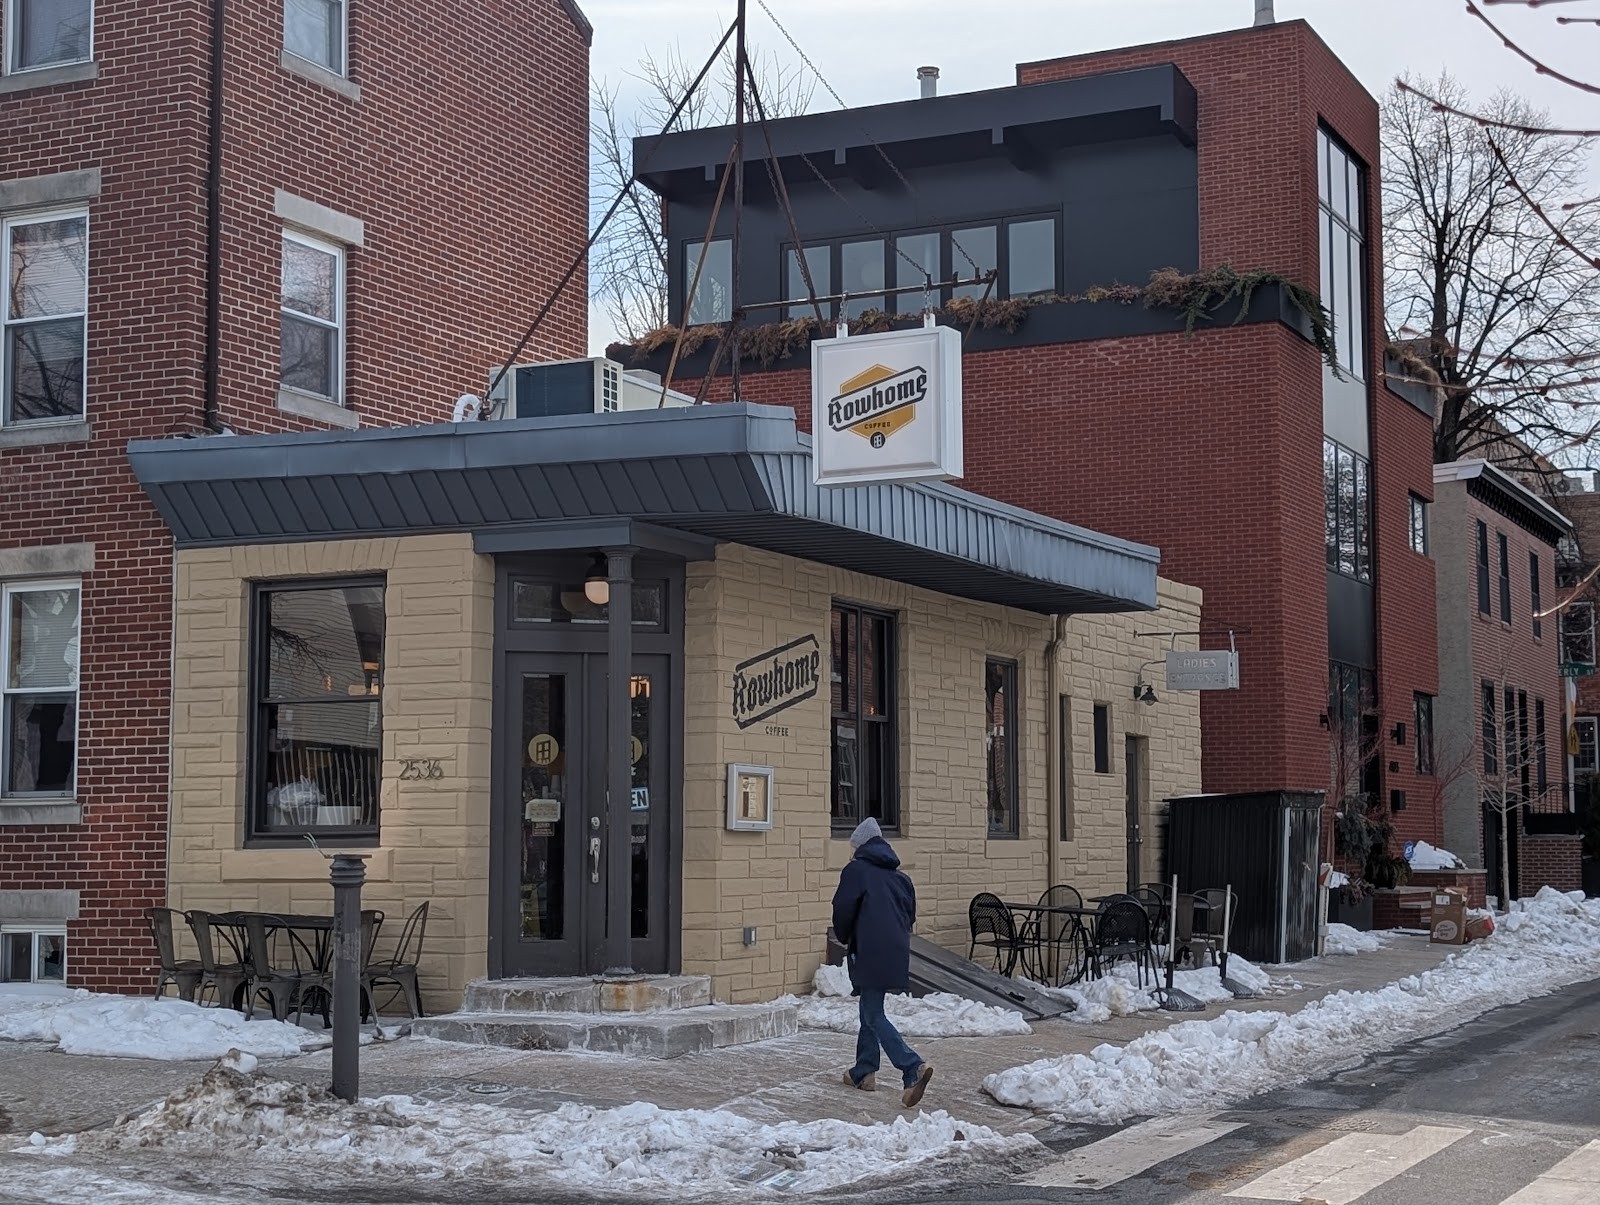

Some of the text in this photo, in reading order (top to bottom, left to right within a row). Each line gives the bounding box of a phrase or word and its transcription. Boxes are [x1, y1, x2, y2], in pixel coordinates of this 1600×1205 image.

[828, 374, 927, 426] Rowhome
[864, 421, 891, 430] COFFEE
[1177, 658, 1217, 668] LADIES
[1558, 667, 1579, 676] ERLY
[732, 650, 819, 717] Rowhome
[765, 726, 789, 737] COFFEE
[399, 759, 444, 781] 2536
[631, 789, 647, 807] EN
